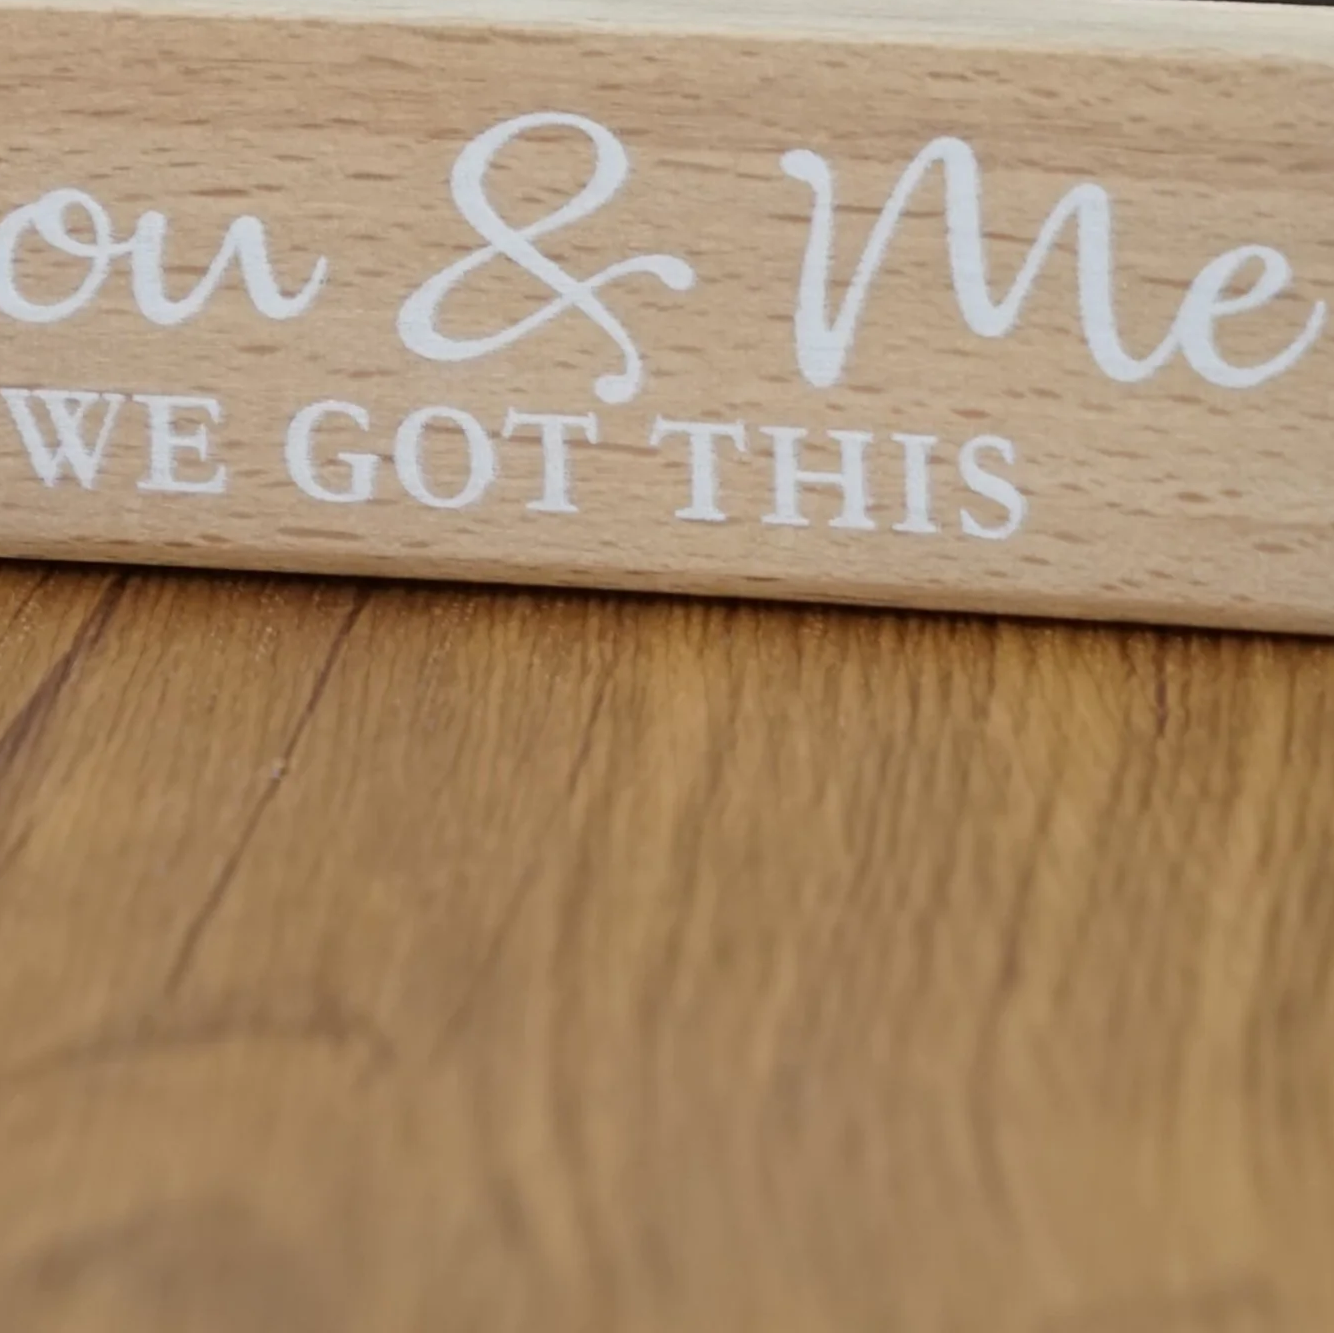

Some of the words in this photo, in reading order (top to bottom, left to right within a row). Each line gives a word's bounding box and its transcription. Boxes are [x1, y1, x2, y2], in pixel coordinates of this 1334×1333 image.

[395, 110, 697, 406] &
[778, 135, 1328, 390] Me
[283, 397, 601, 515] GOT
[647, 414, 1028, 541] THIS
